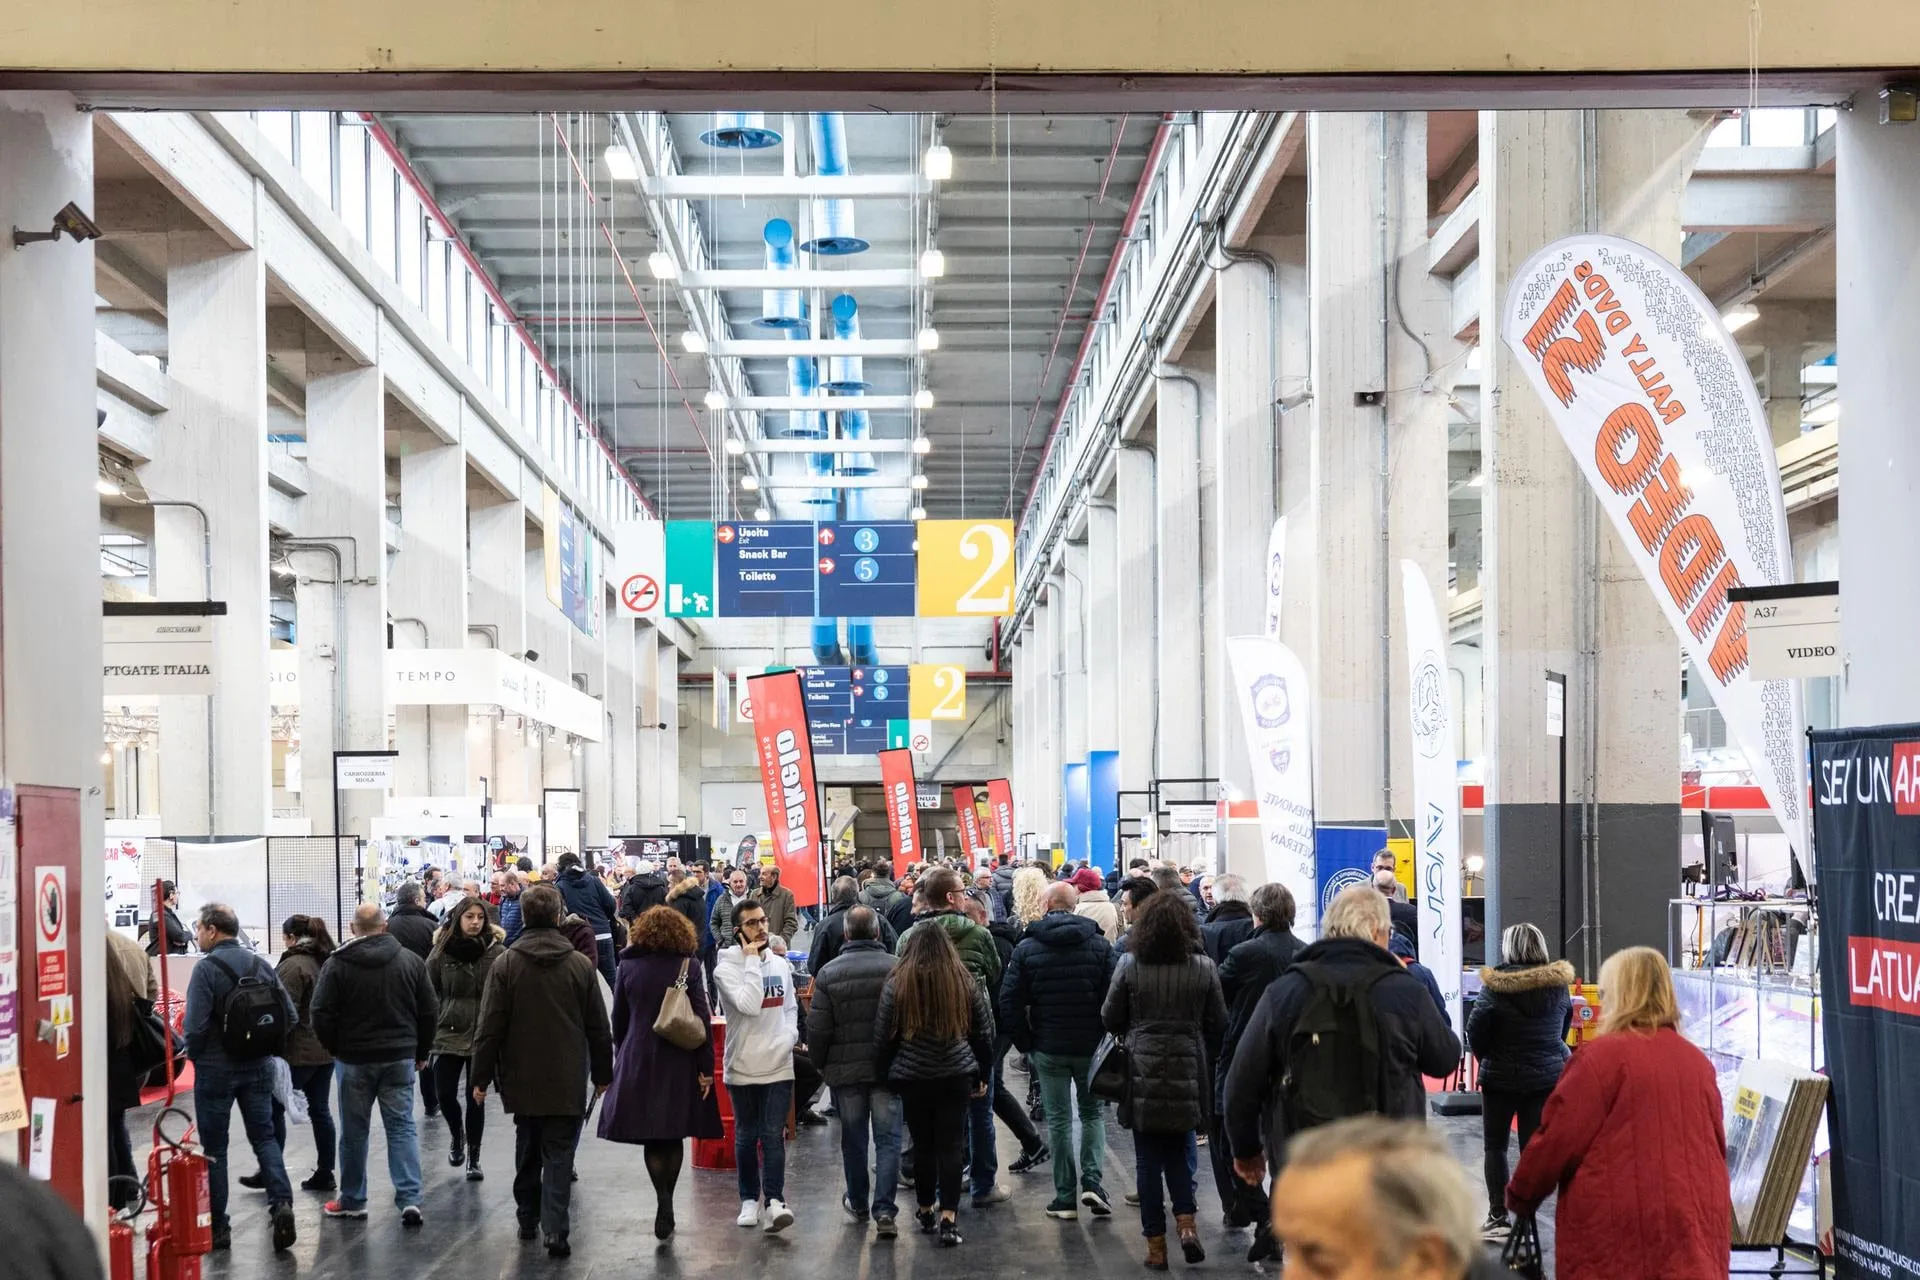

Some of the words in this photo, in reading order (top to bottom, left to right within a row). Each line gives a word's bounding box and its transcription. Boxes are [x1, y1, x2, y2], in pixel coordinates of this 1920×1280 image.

[738, 528, 768, 537] Uscita
[860, 531, 872, 550] 3
[739, 550, 768, 559] Snack
[771, 550, 787, 559] Bar
[860, 560, 872, 579] 5
[956, 524, 1011, 613] 2
[739, 572, 776, 581] Toilette
[1754, 606, 1778, 618] A37
[1787, 646, 1836, 659] VIDEO
[164, 664, 210, 676] ITALIA
[396, 671, 456, 681] TEMPO
[931, 666, 963, 718] 2
[1820, 758, 1850, 805] SEI
[1856, 756, 1892, 804] UN
